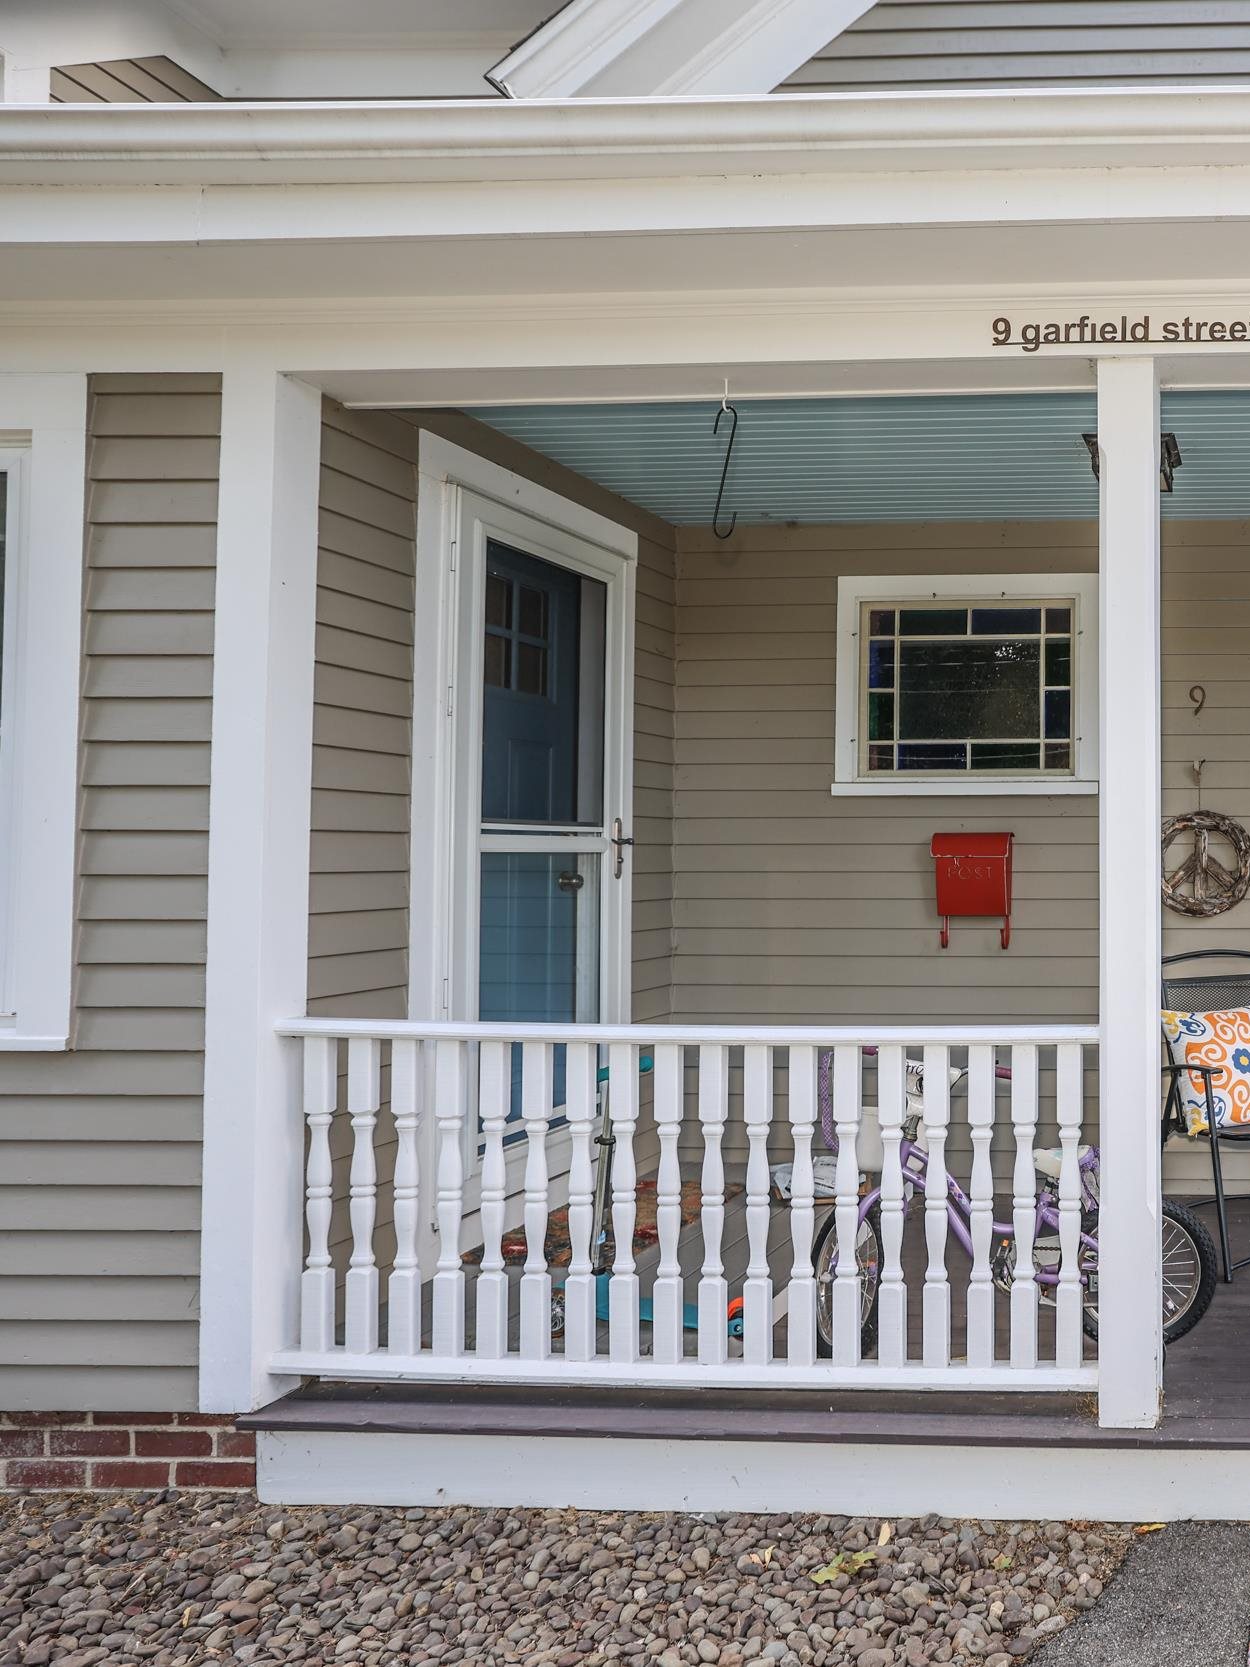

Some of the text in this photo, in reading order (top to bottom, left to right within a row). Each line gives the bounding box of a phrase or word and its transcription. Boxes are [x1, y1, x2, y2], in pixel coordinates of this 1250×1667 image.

[992, 317, 1012, 345] 9
[1021, 315, 1151, 352] garfield
[1189, 685, 1206, 716] 9
[947, 865, 993, 880] POST
